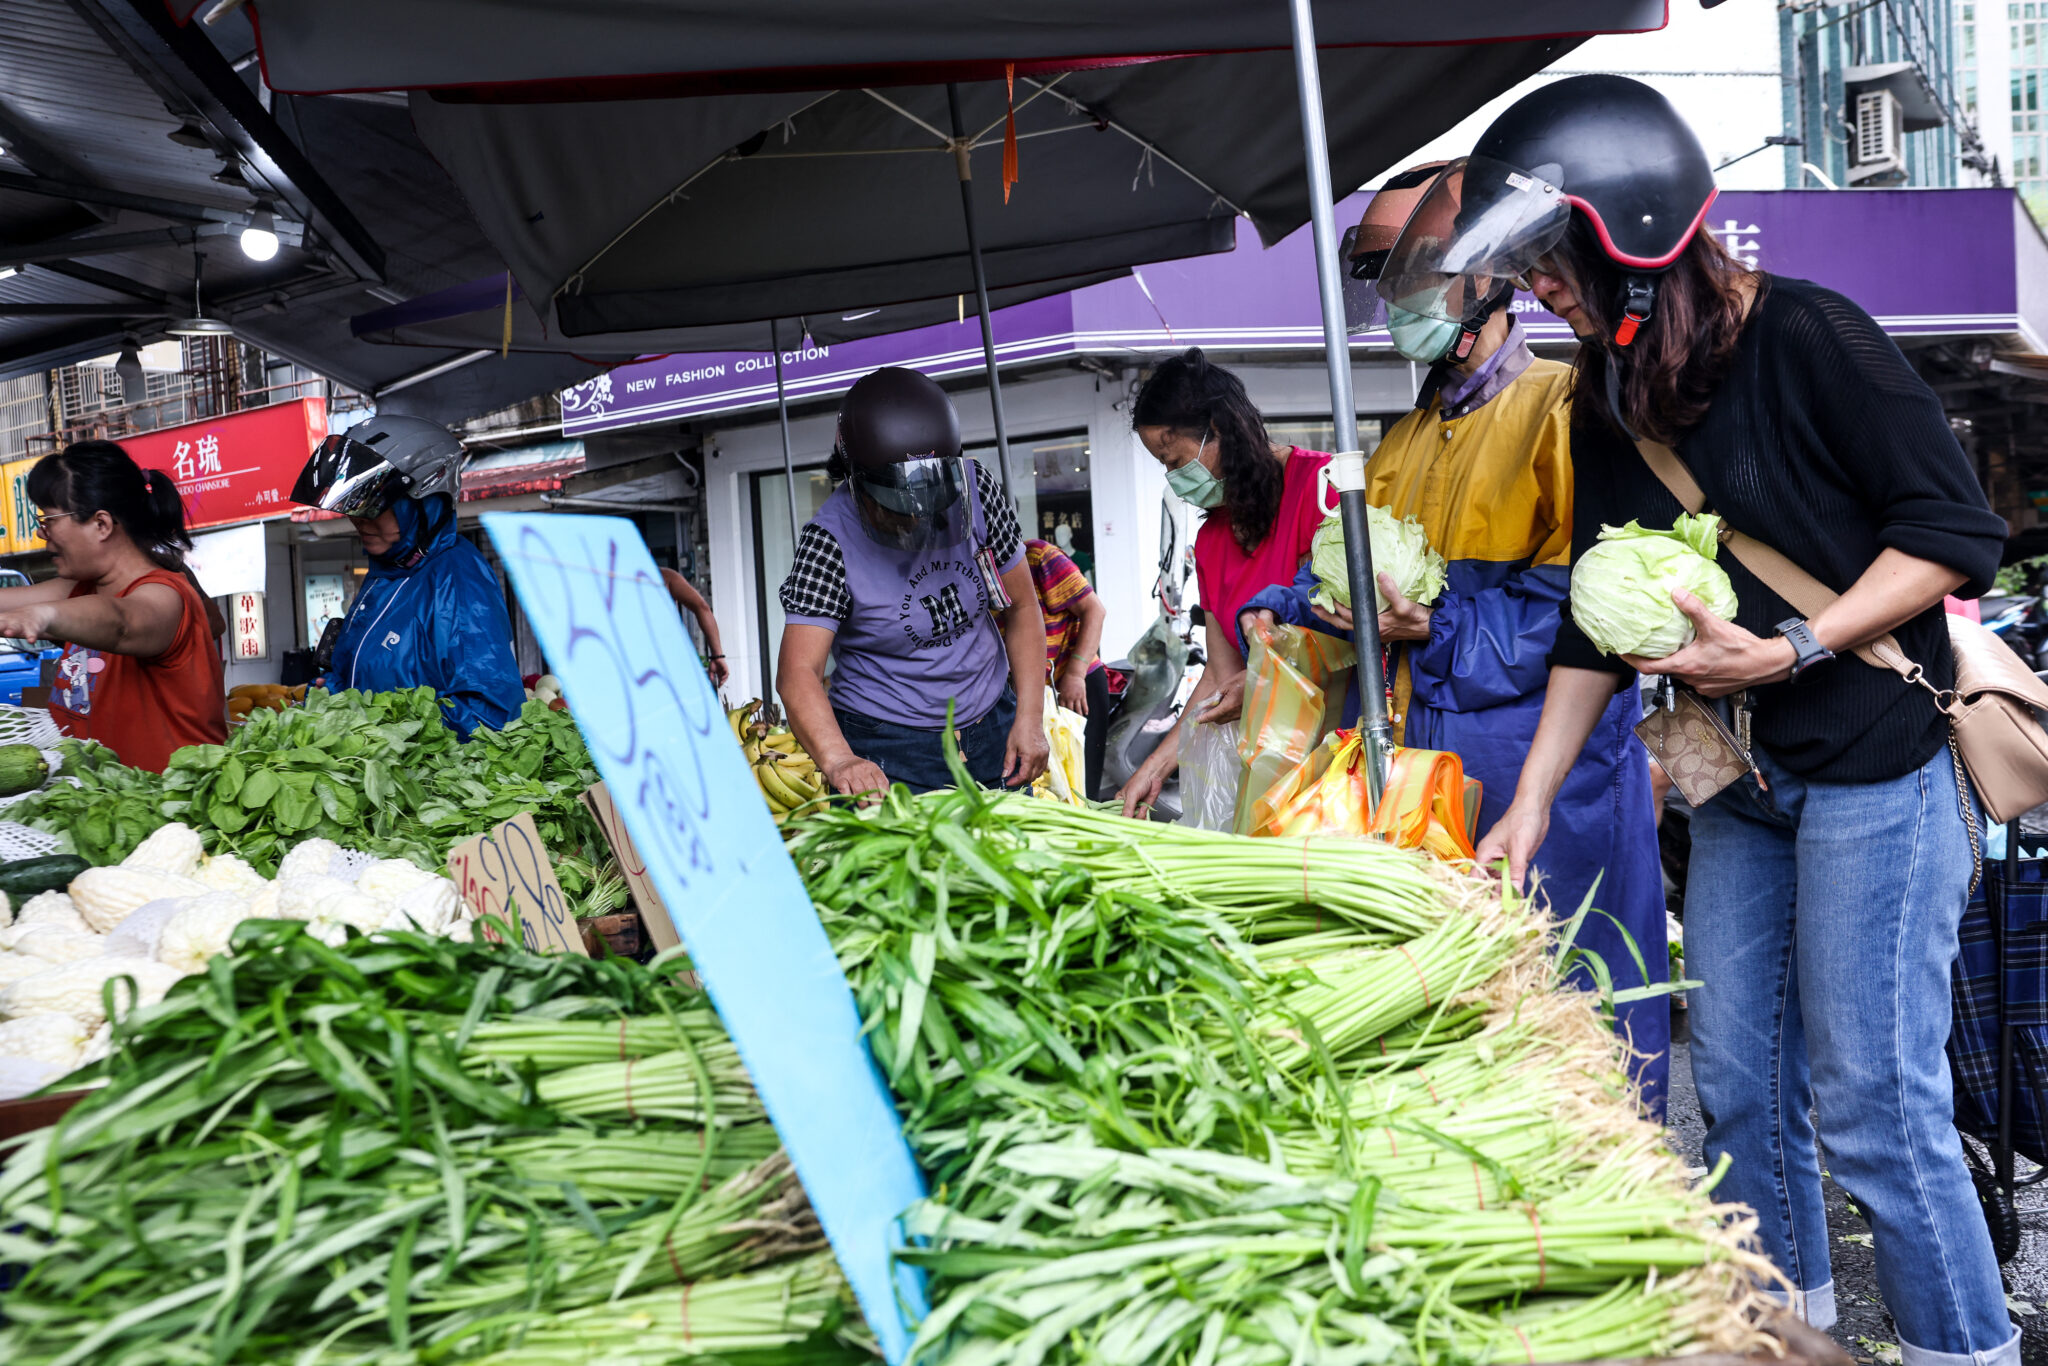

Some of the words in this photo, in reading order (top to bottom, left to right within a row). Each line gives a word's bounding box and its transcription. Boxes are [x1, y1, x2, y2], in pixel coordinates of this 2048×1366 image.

[626, 377, 657, 394] NEW
[665, 364, 725, 386] FASHION
[899, 594, 912, 620] You
[909, 565, 928, 589] And
[931, 561, 950, 573] Mr
[919, 582, 969, 638] M
